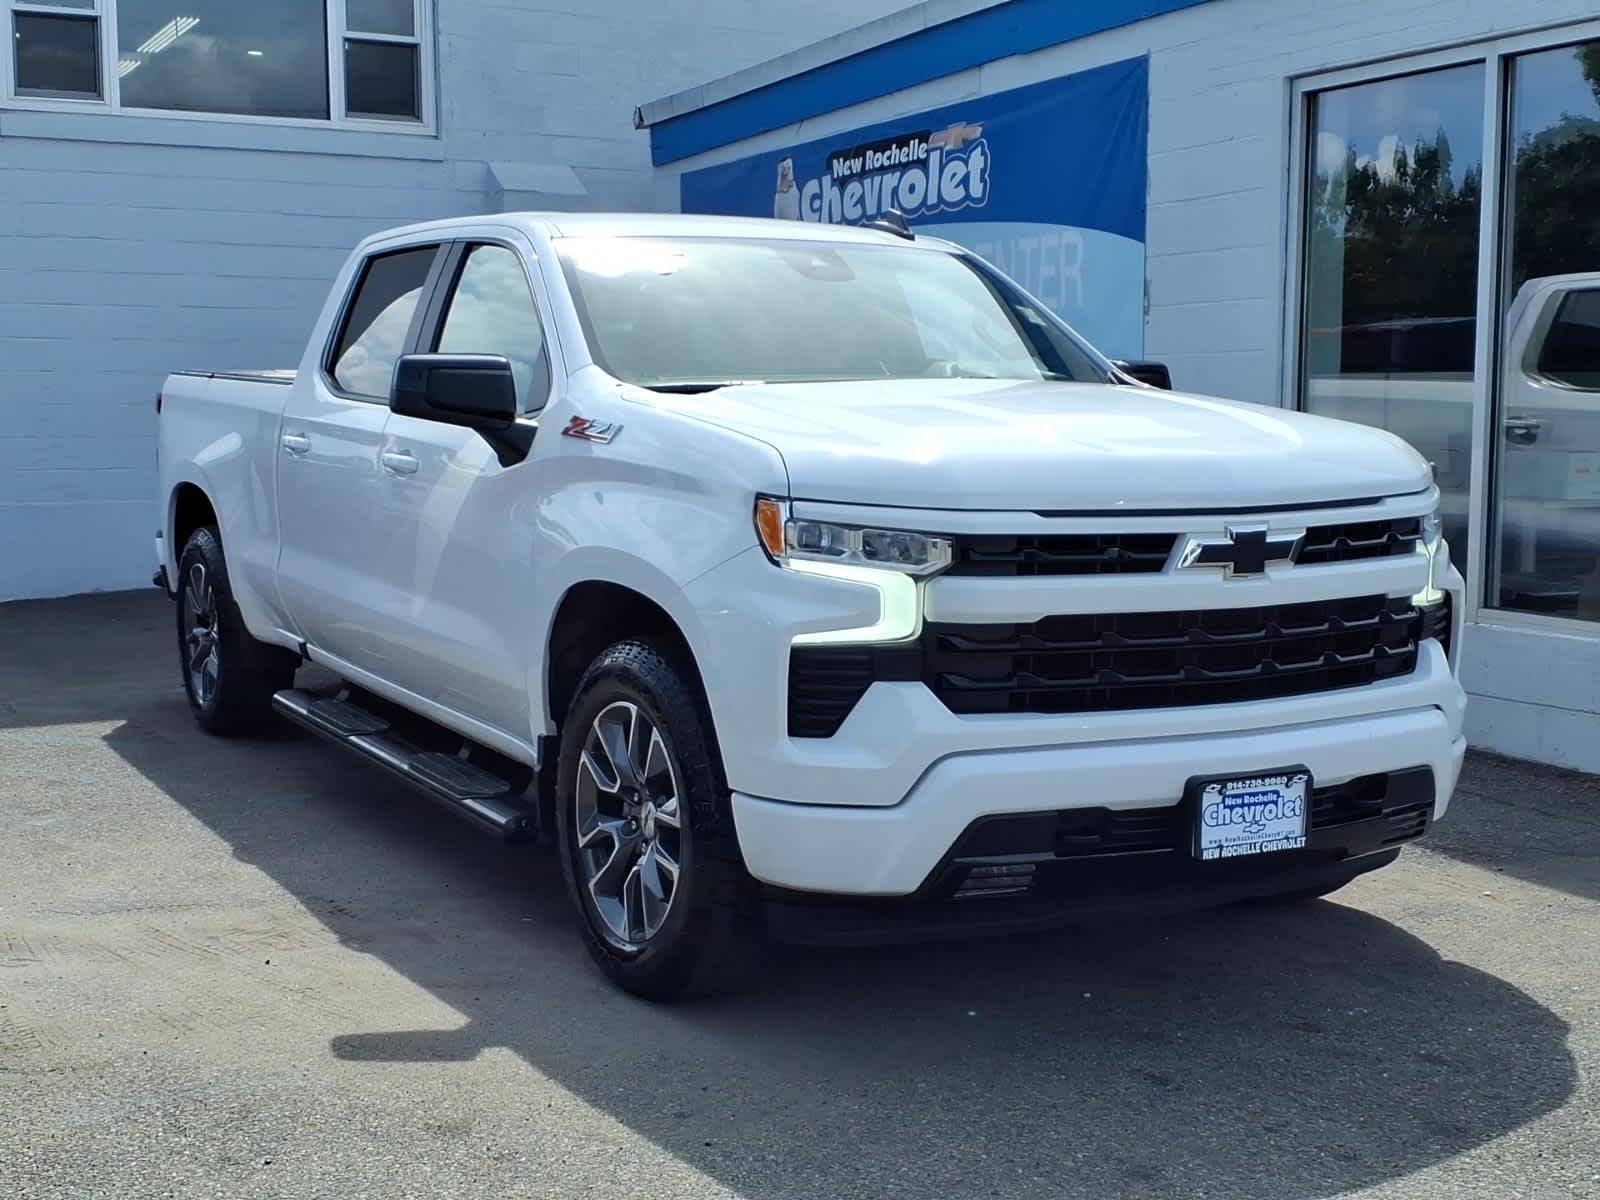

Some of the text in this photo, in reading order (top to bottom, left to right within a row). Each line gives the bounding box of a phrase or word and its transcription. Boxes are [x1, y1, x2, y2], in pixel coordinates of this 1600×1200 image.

[833, 138, 927, 178] New Rochelle
[801, 146, 985, 223] Chevrolet
[560, 416, 625, 445] Z71
[1203, 794, 1303, 827] Chevrolet
[1224, 791, 1278, 806] New Rochelle
[1203, 837, 1306, 861] NEW ROCHELLE CHEVROLET
